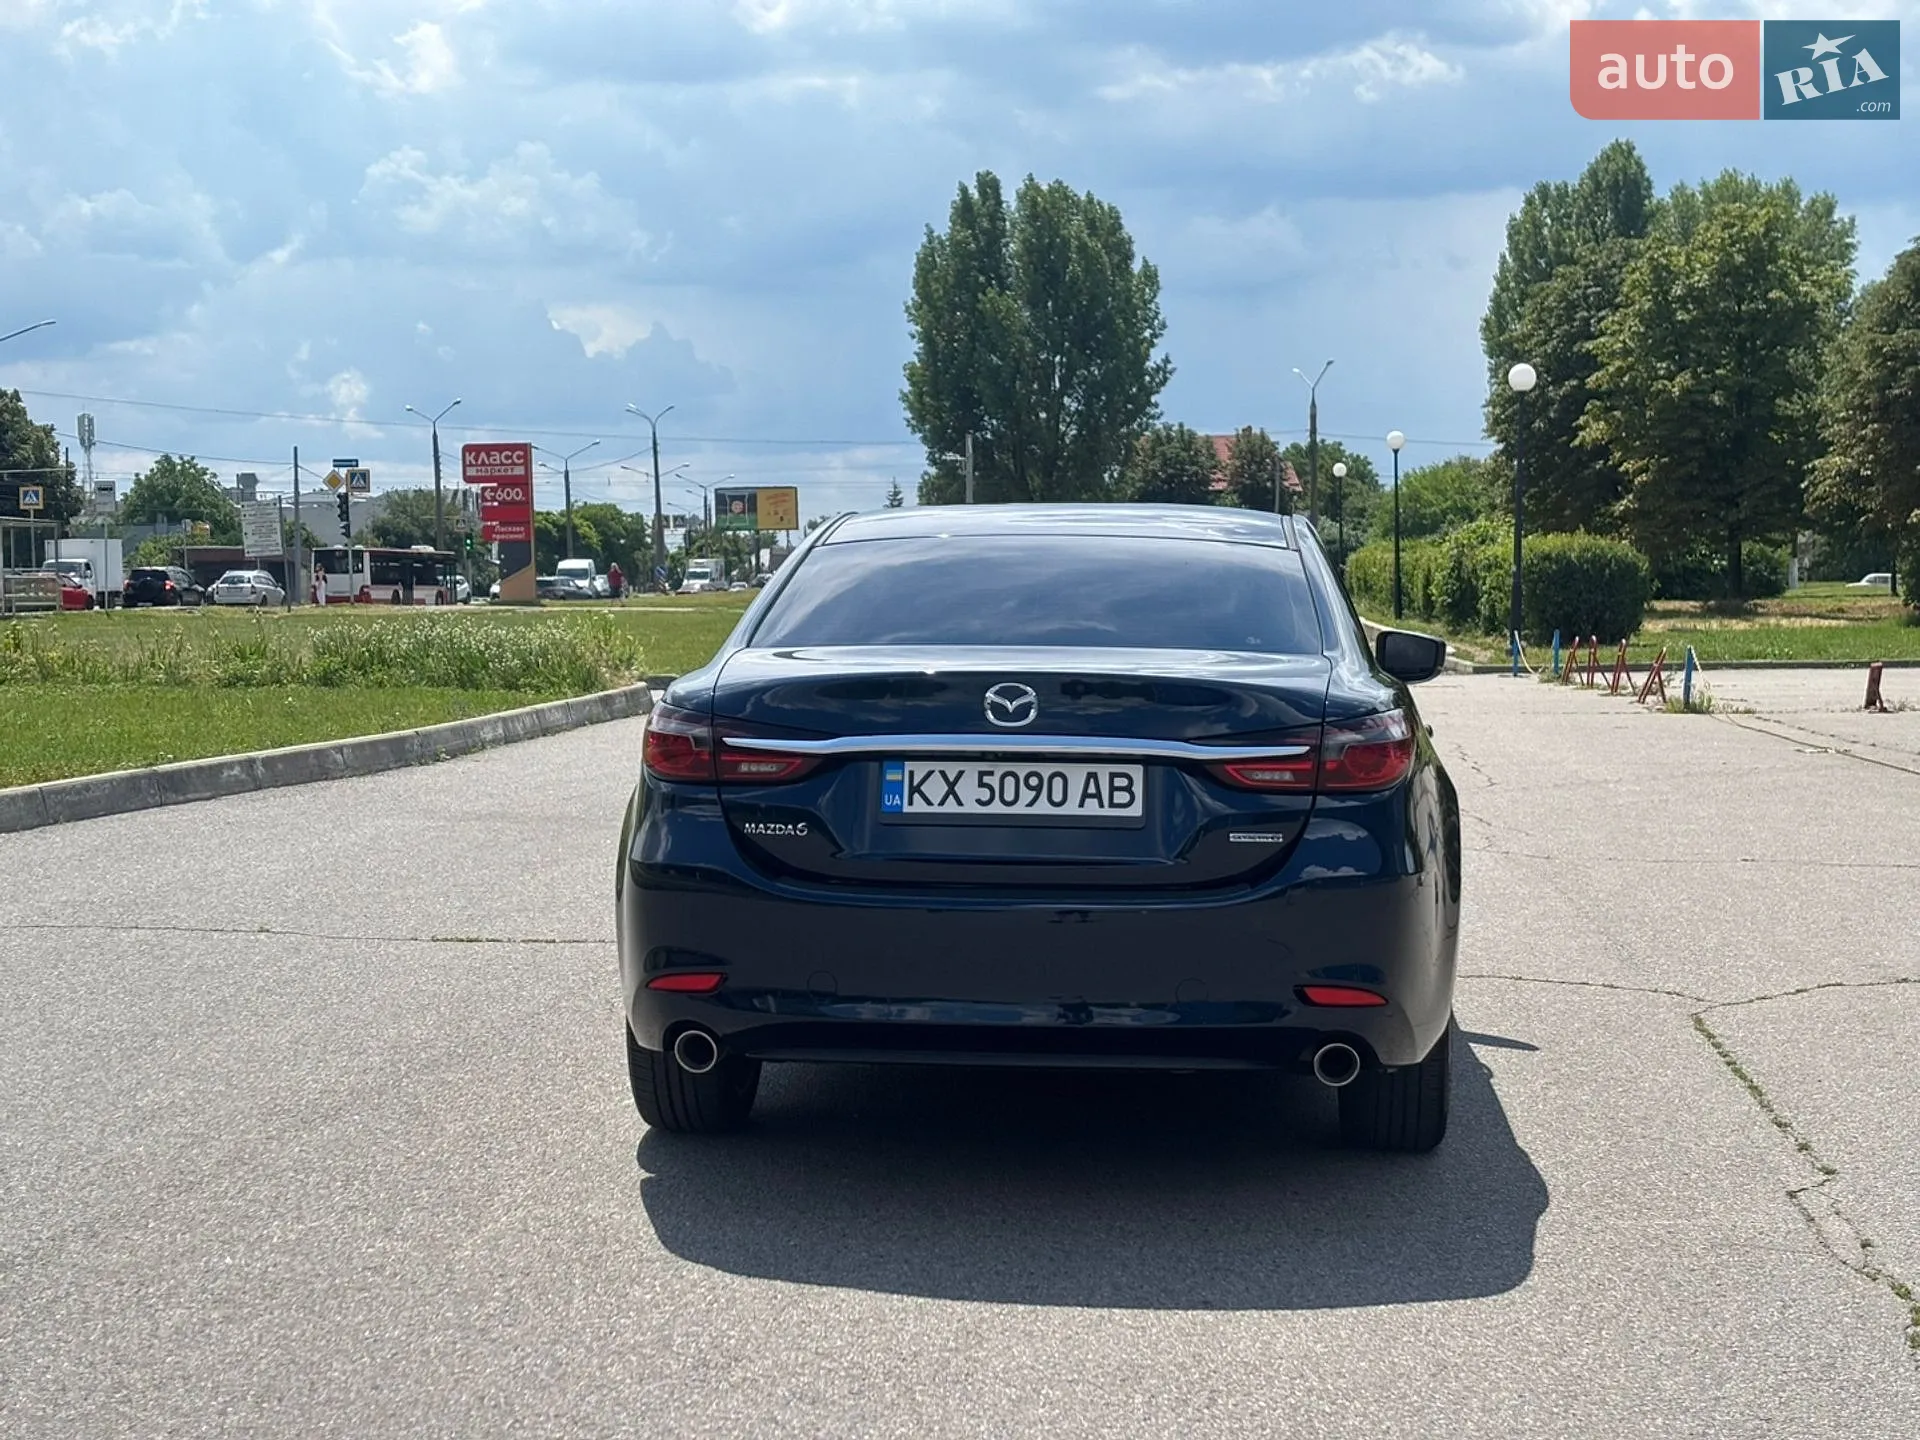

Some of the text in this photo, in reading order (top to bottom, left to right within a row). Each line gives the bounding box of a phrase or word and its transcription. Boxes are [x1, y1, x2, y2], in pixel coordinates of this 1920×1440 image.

[884, 794, 901, 806] UA
[907, 769, 1136, 809] KX 5090 AB
